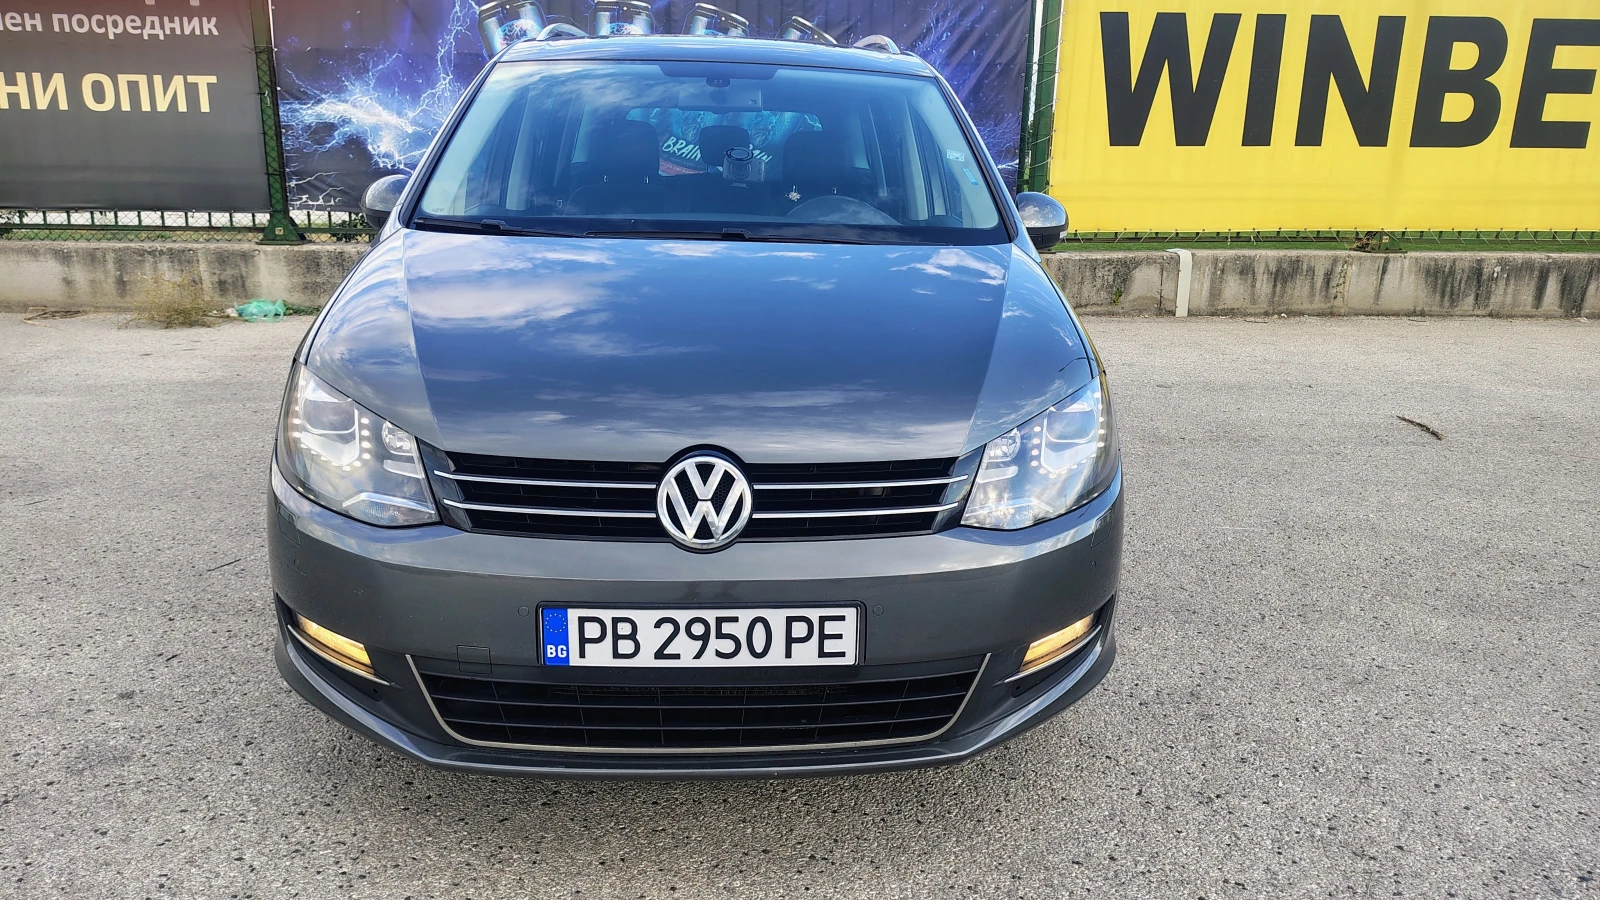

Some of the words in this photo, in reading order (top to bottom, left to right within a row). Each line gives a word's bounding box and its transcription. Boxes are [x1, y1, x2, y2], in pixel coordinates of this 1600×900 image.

[0, 12, 43, 32] ен
[52, 14, 219, 40] посредник
[0, 71, 69, 111] НИ
[82, 73, 218, 113] ОПИТ
[1099, 12, 1600, 149] WINBE
[662, 136, 701, 161] BRAIN
[546, 645, 567, 658] BG
[577, 616, 641, 660] PB
[653, 616, 773, 660] 2950
[785, 615, 846, 659] PE
